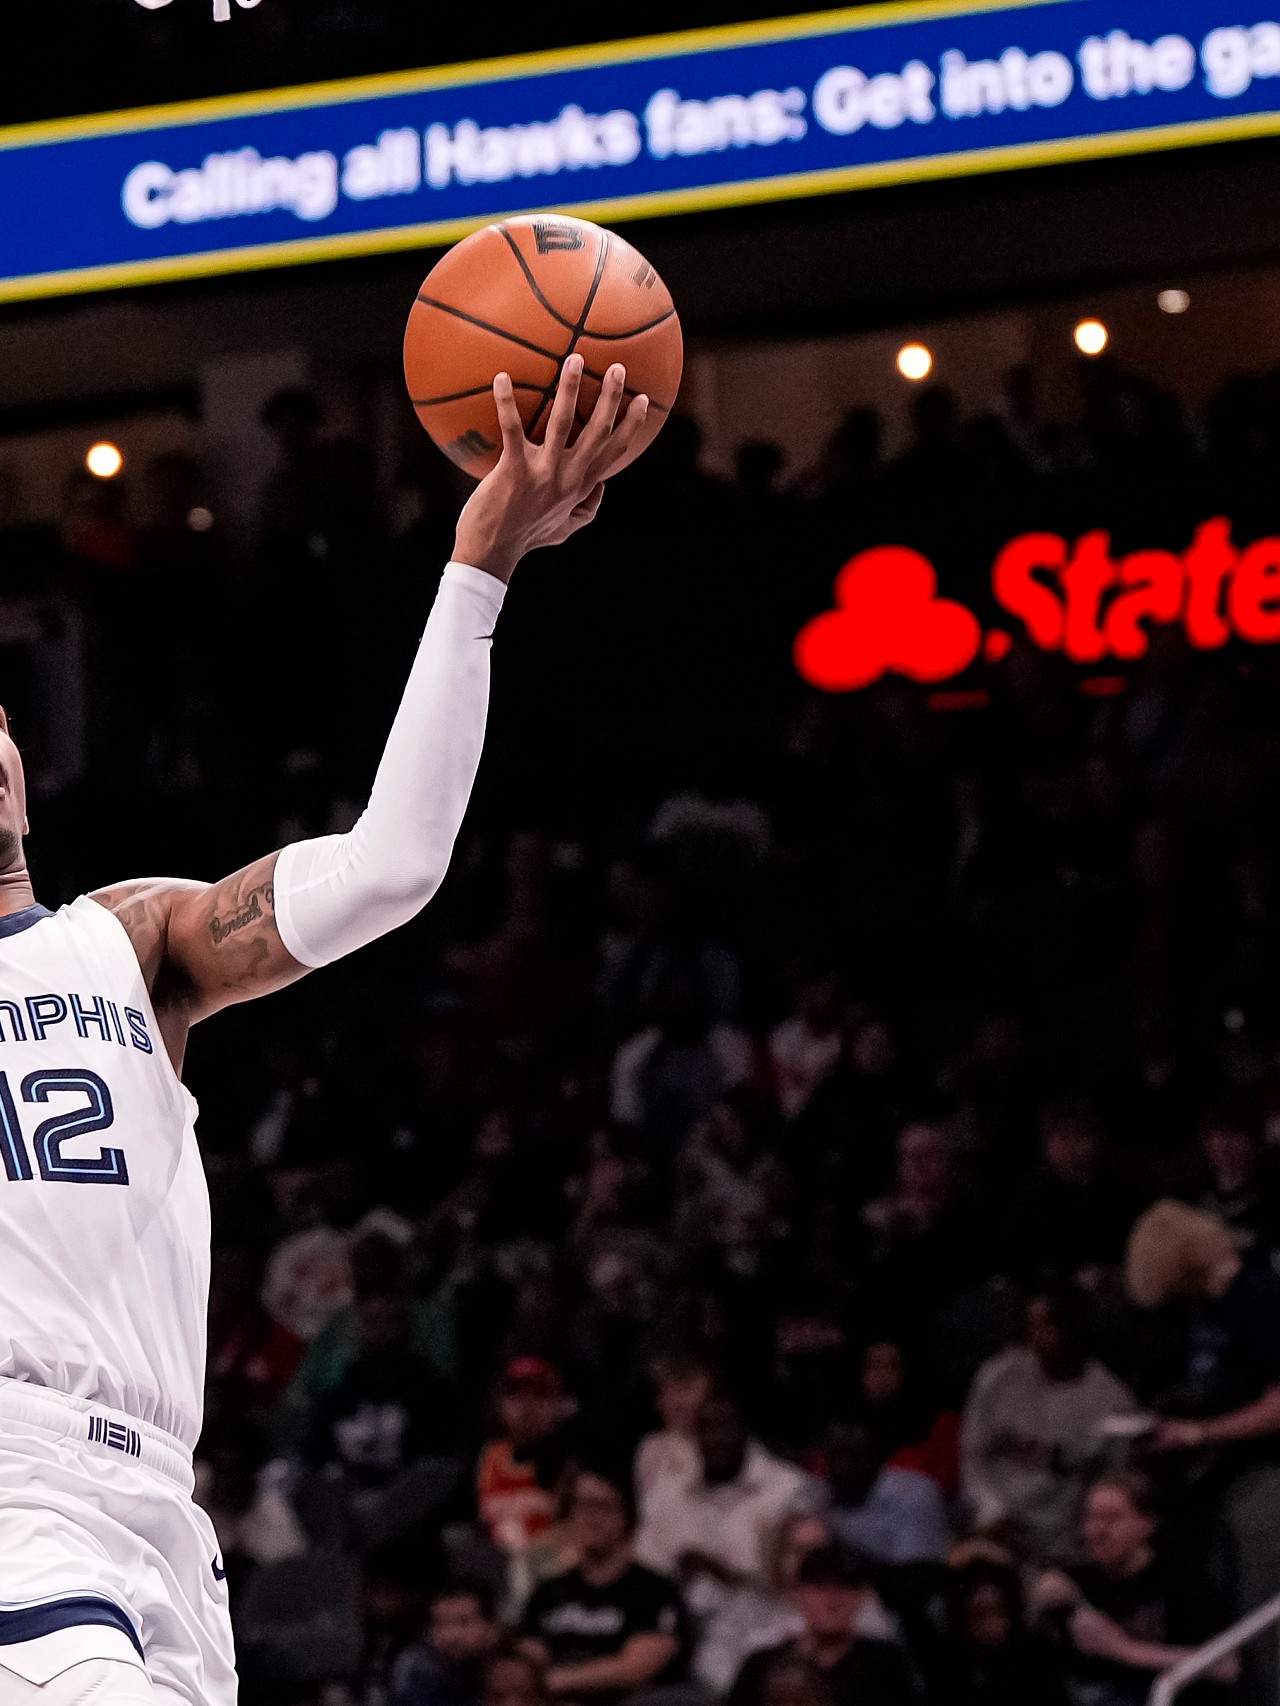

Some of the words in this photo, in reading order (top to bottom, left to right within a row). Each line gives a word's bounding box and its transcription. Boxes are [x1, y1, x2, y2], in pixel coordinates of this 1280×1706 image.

[123, 148, 338, 229] Calling
[342, 127, 421, 200] all
[424, 104, 641, 189] Hawks
[645, 88, 807, 159] fans:
[813, 64, 935, 136] Get
[940, 48, 1073, 119] into
[1079, 30, 1196, 100] the
[991, 516, 1280, 664] State
